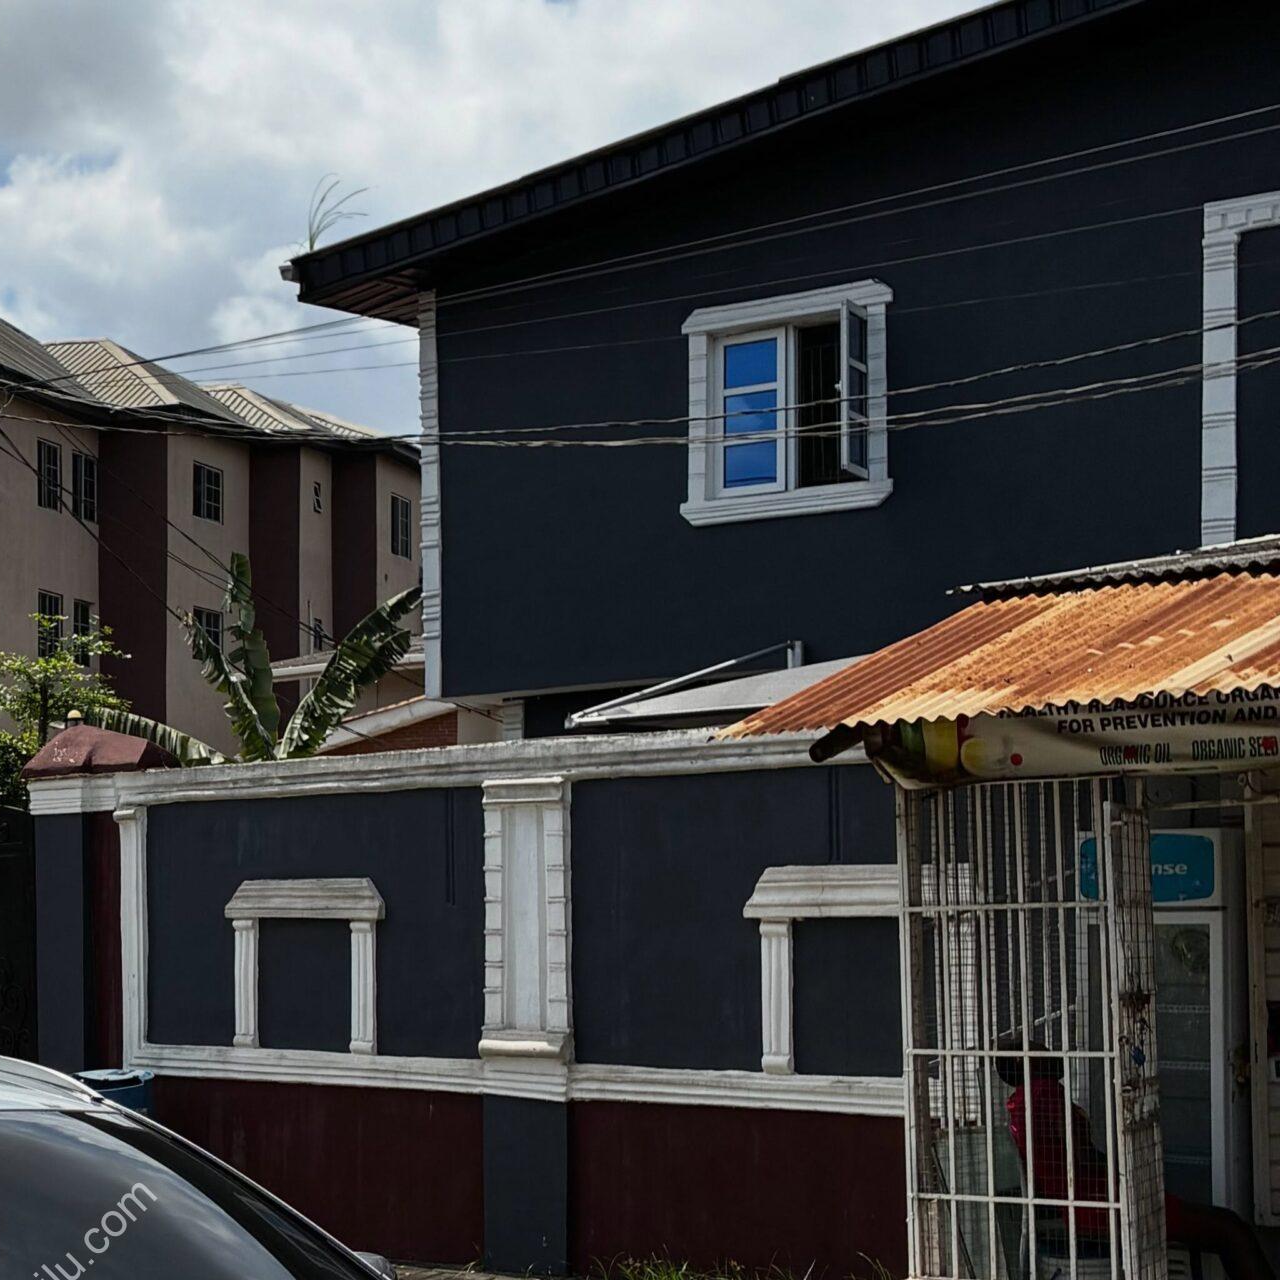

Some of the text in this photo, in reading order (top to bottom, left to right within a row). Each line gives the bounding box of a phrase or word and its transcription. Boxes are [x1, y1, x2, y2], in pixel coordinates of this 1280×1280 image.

[1216, 685, 1280, 704] ORGA
[1057, 705, 1278, 734] FOR PREVENTION AND
[1100, 743, 1173, 766] ORGANIC OIL
[1192, 738, 1245, 761] ORGANIC
